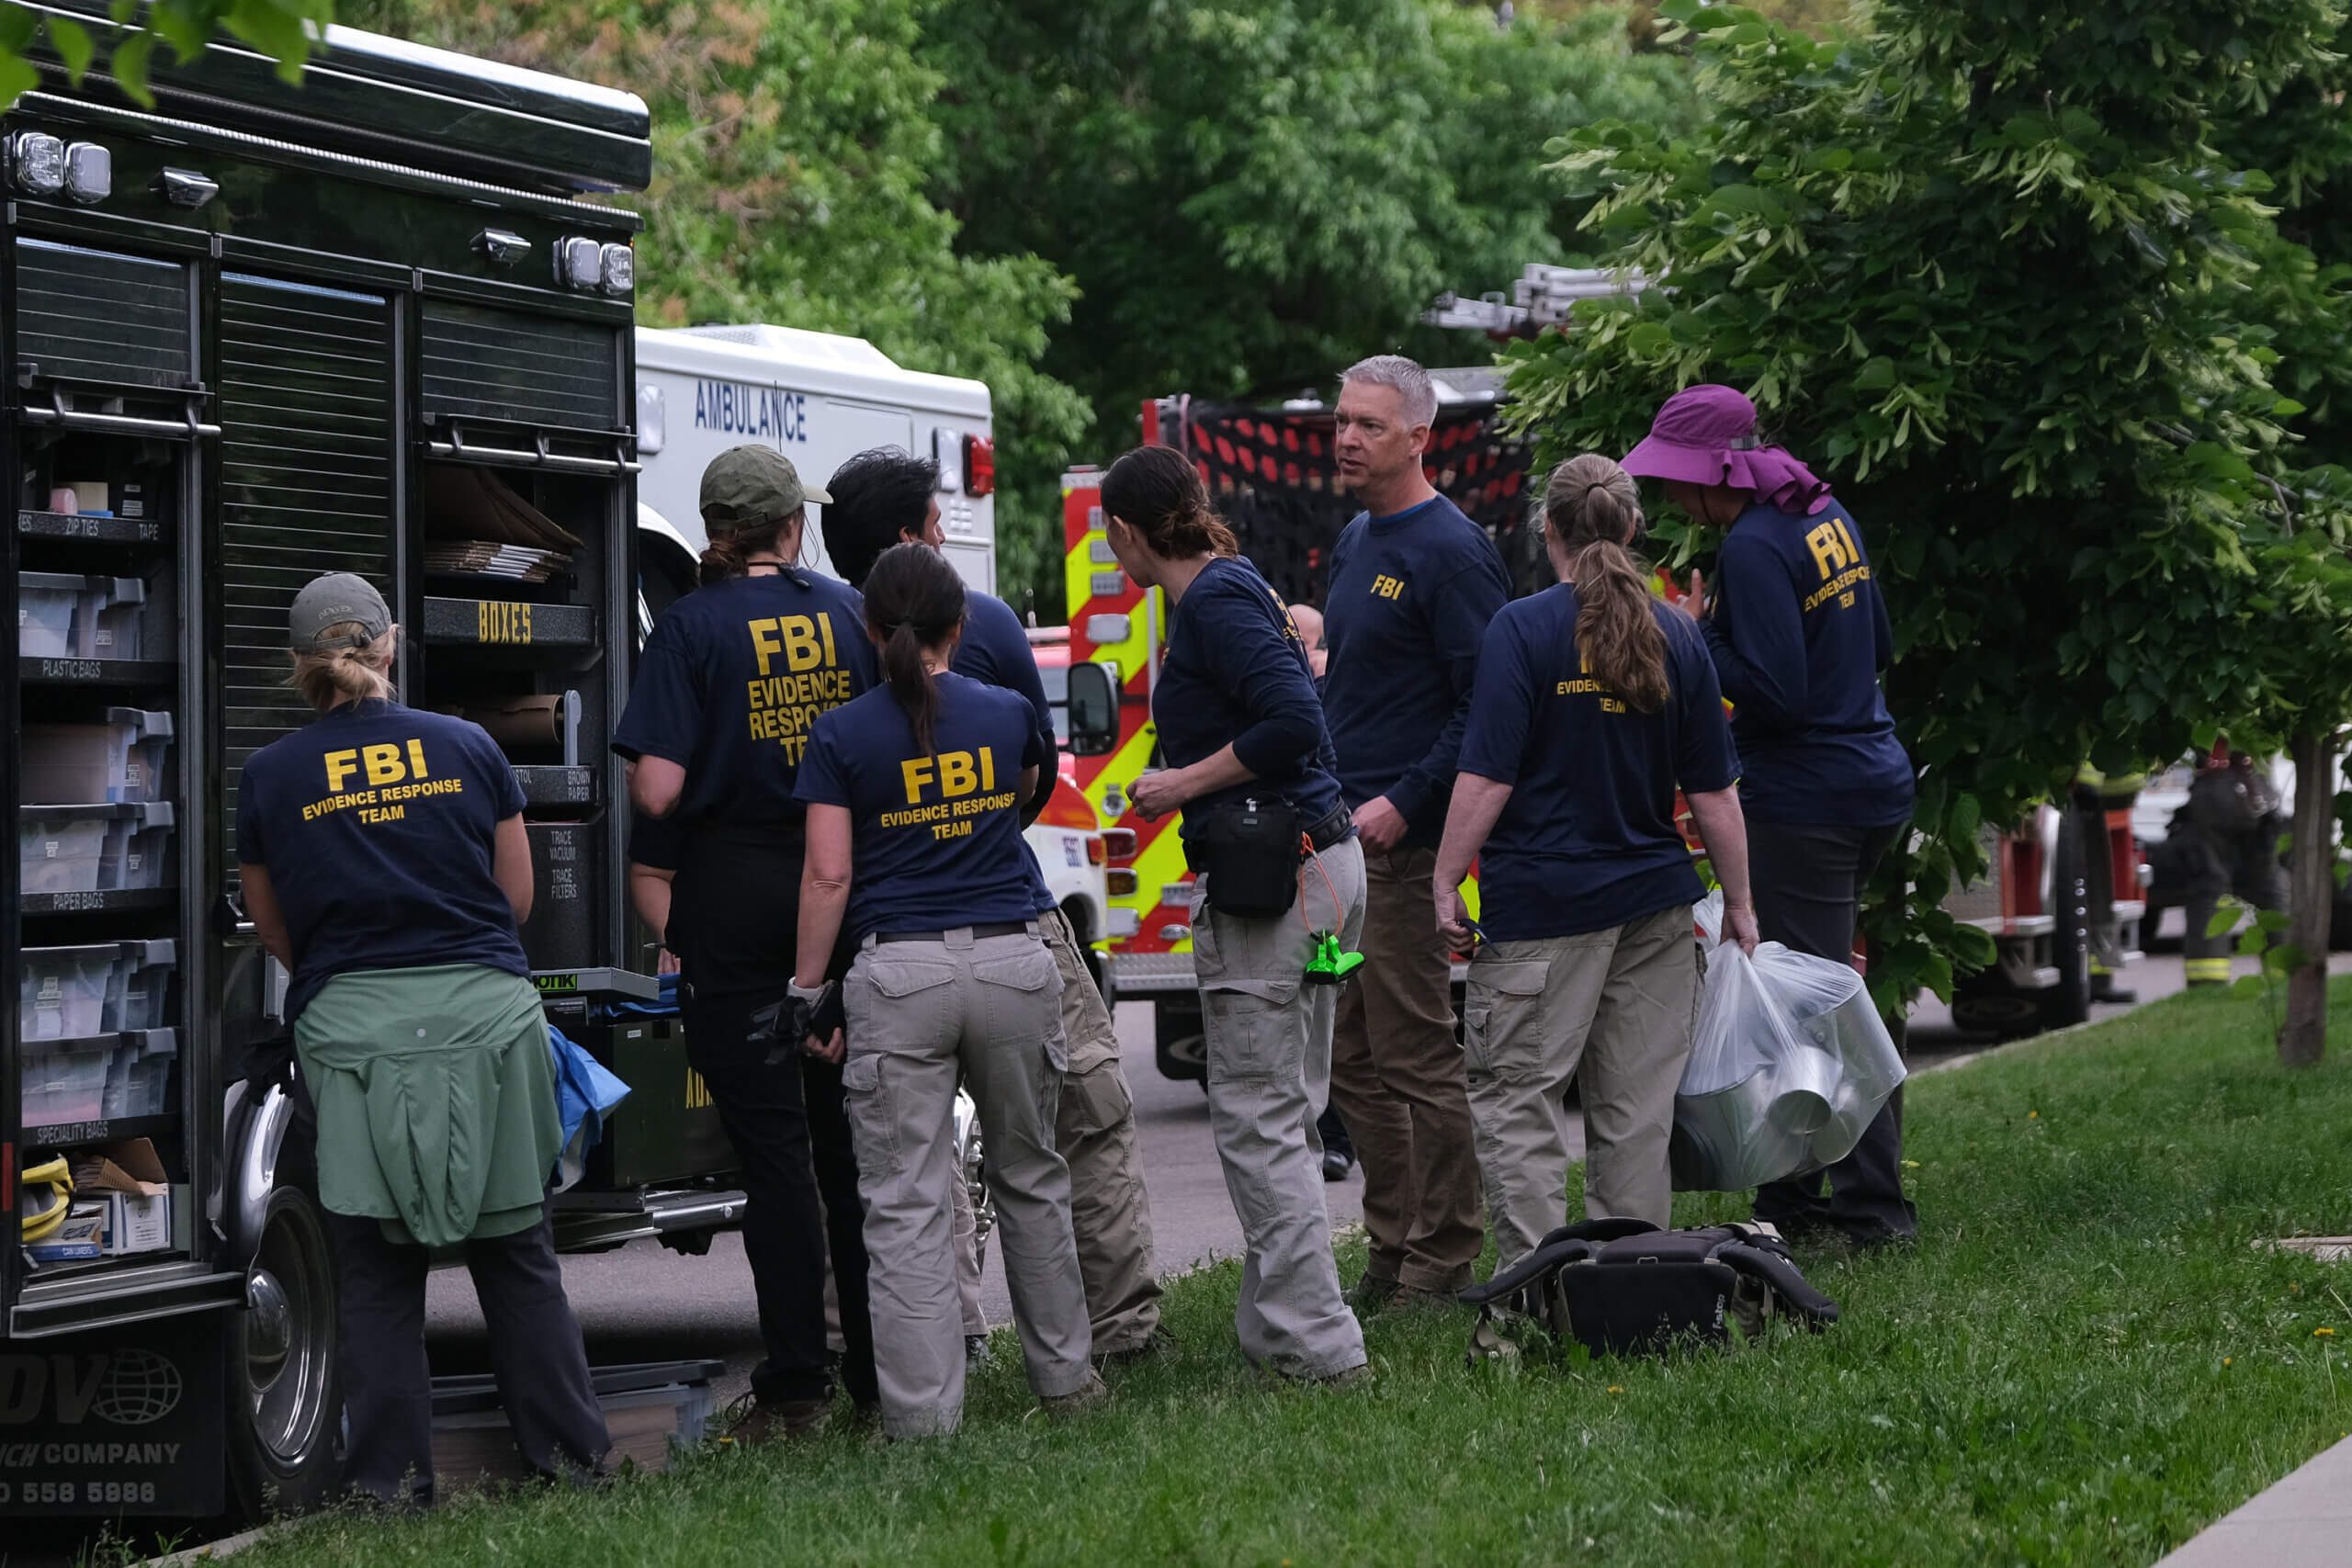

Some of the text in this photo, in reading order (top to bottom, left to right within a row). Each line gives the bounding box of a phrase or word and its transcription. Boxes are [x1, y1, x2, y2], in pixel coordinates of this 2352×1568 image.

[695, 380, 807, 443] AMBULANCE
[65, 518, 99, 536] ZIP TIES
[140, 524, 159, 540] TAPE
[1805, 517, 1860, 581] FBI
[1370, 573, 1405, 601] FBI
[479, 602, 532, 643] BOXES
[748, 612, 837, 676] FBI
[43, 660, 101, 678] PLASTIC BAGS
[747, 670, 851, 709] EVIDENCE
[1556, 679, 1610, 695] EVIDEN
[749, 701, 851, 740] RESPO
[780, 735, 808, 766] TE
[324, 739, 428, 792] FBI
[901, 746, 995, 804] FBI
[514, 769, 532, 784] STOL
[568, 771, 591, 786] BROWN
[302, 779, 463, 821] EVIDENCE RESPONSE
[568, 786, 590, 801] PAPER
[358, 805, 405, 824] TEAM
[881, 804, 950, 828] EVIDENCE
[551, 830, 571, 845] TRACE
[932, 819, 973, 840] TEAM
[549, 846, 576, 861] VACUUM
[552, 868, 572, 884] TRACE
[53, 892, 104, 910] PAPER BAGS
[552, 884, 577, 899] FILTERS
[37, 1121, 108, 1145] SPECIALITY BAGS
[44, 1443, 181, 1464] COMPANY
[22, 1482, 75, 1503] 558
